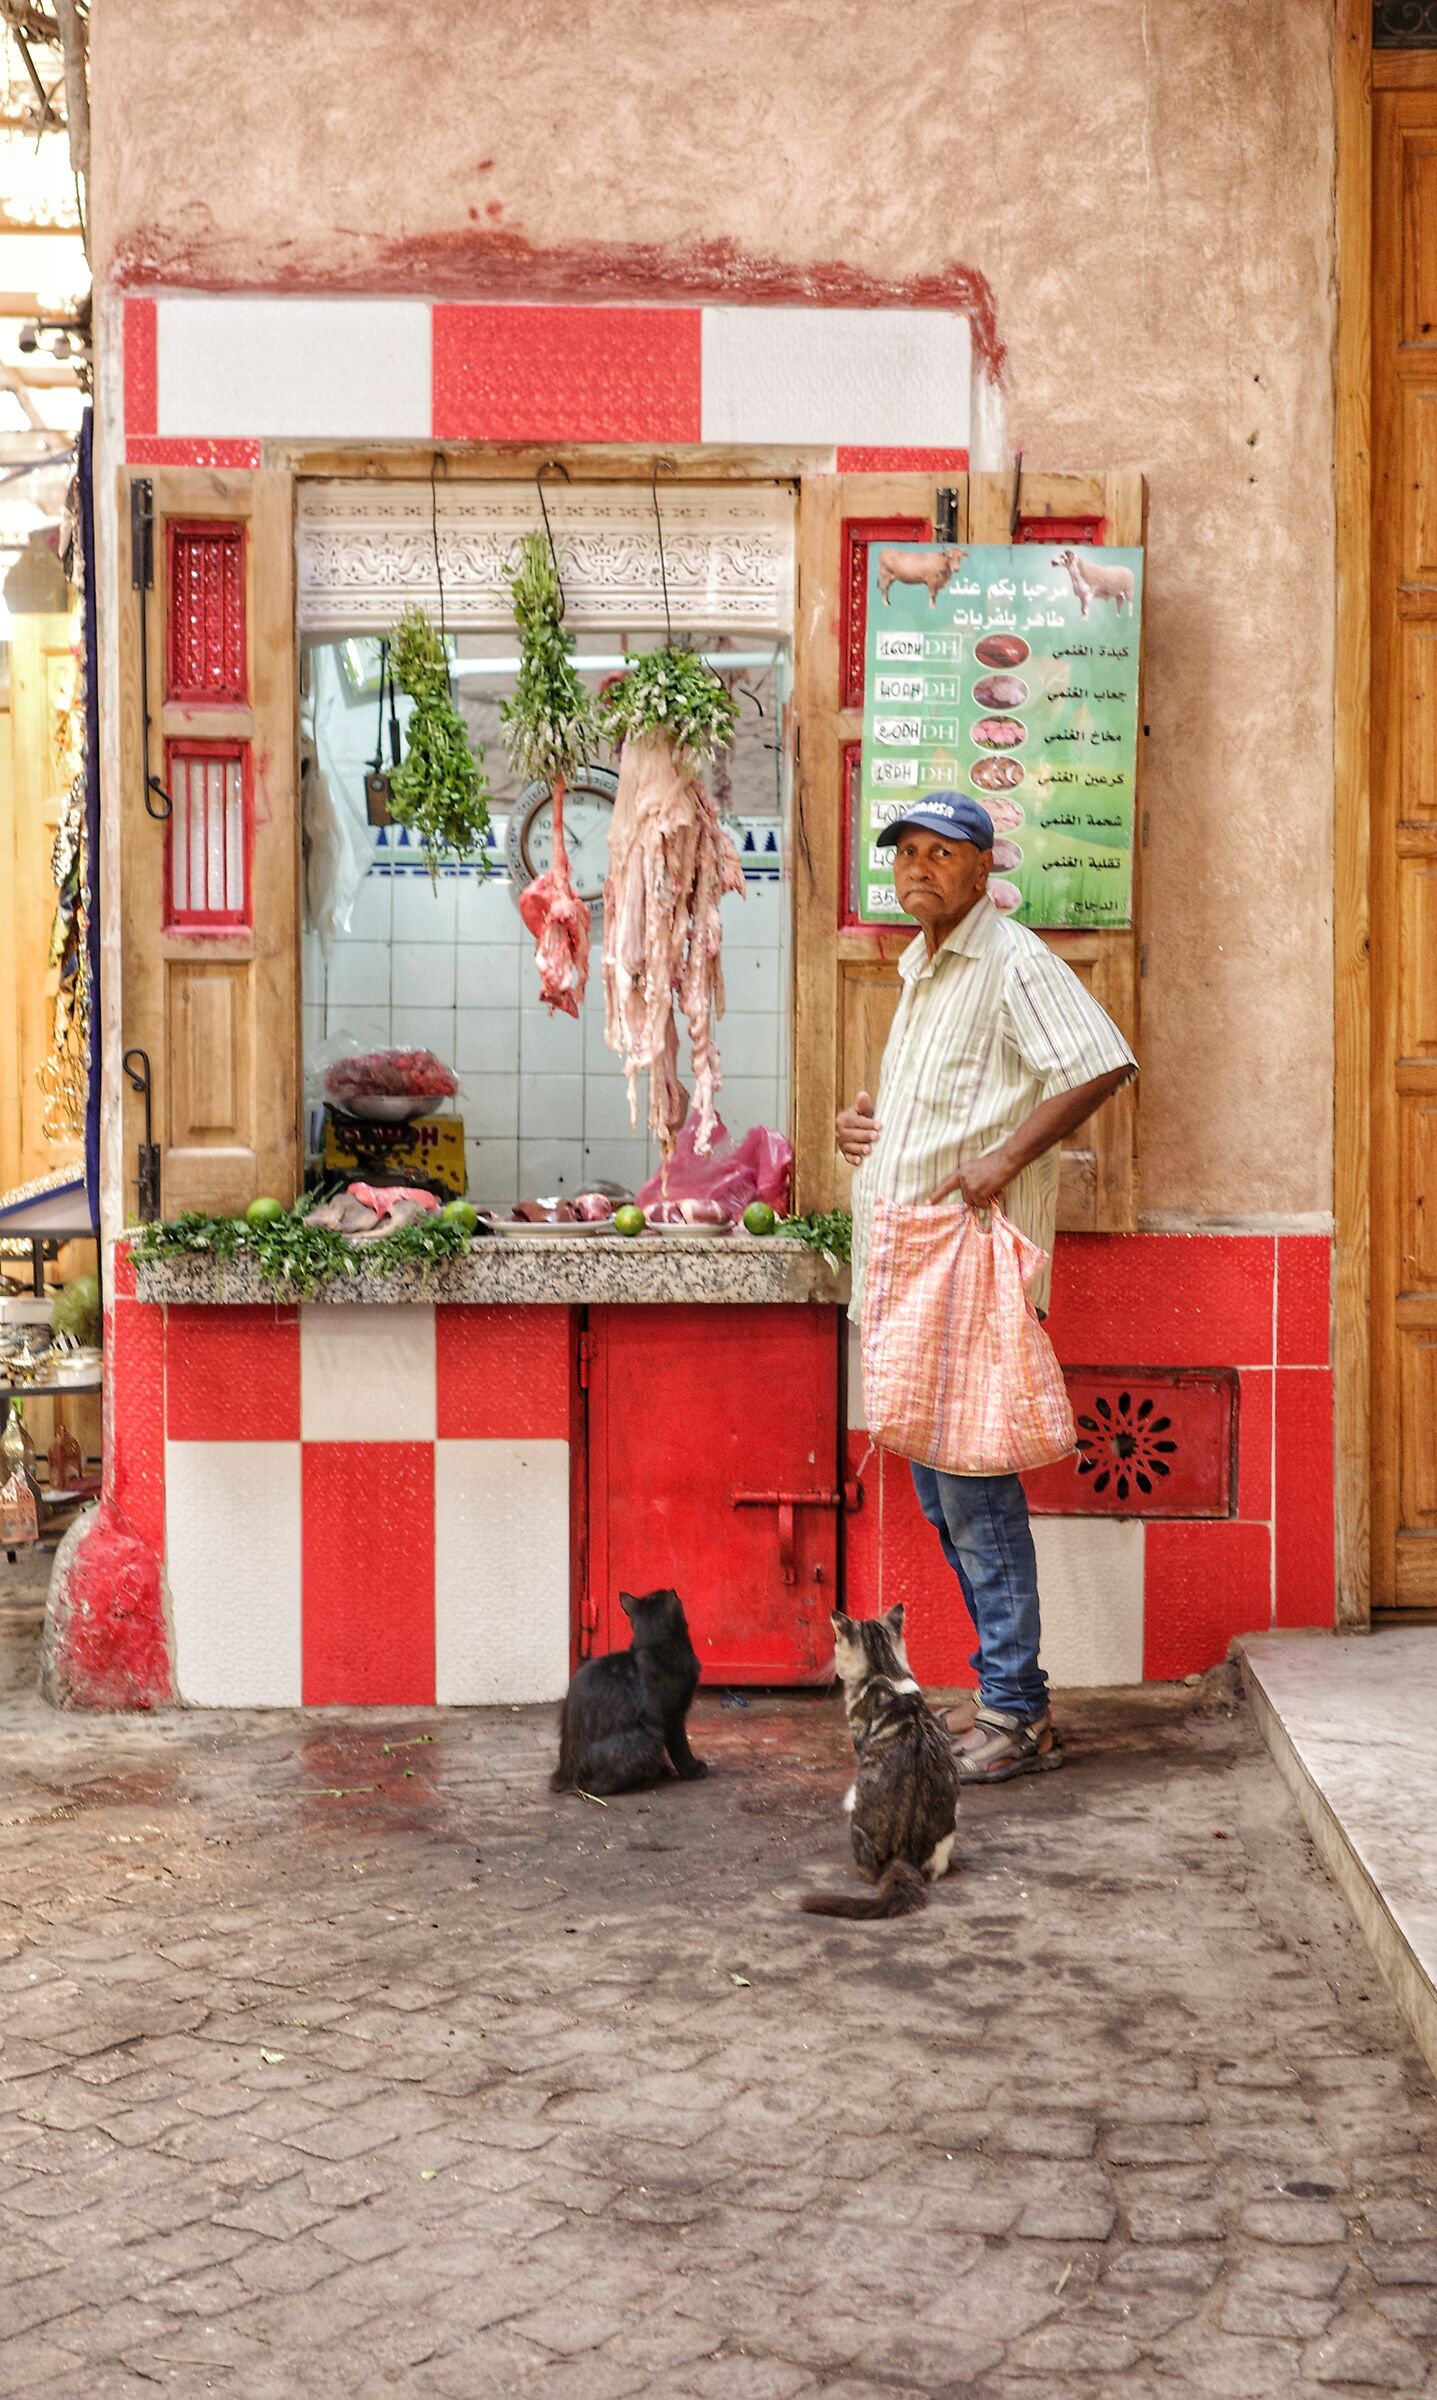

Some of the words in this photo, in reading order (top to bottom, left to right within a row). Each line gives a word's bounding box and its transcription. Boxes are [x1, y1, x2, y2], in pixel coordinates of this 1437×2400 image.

[949, 577, 981, 596] عند
[987, 578, 1016, 602] بكم
[1023, 580, 1069, 602] مرحبا
[1020, 609, 1065, 631] طاهر
[925, 640, 957, 656] DH
[1099, 645, 1129, 661] كبدة
[924, 681, 956, 698] DH
[922, 724, 954, 740] DH
[920, 766, 952, 782] DH
[877, 802, 910, 823] 40D
[1074, 900, 1118, 913] الدجاج
